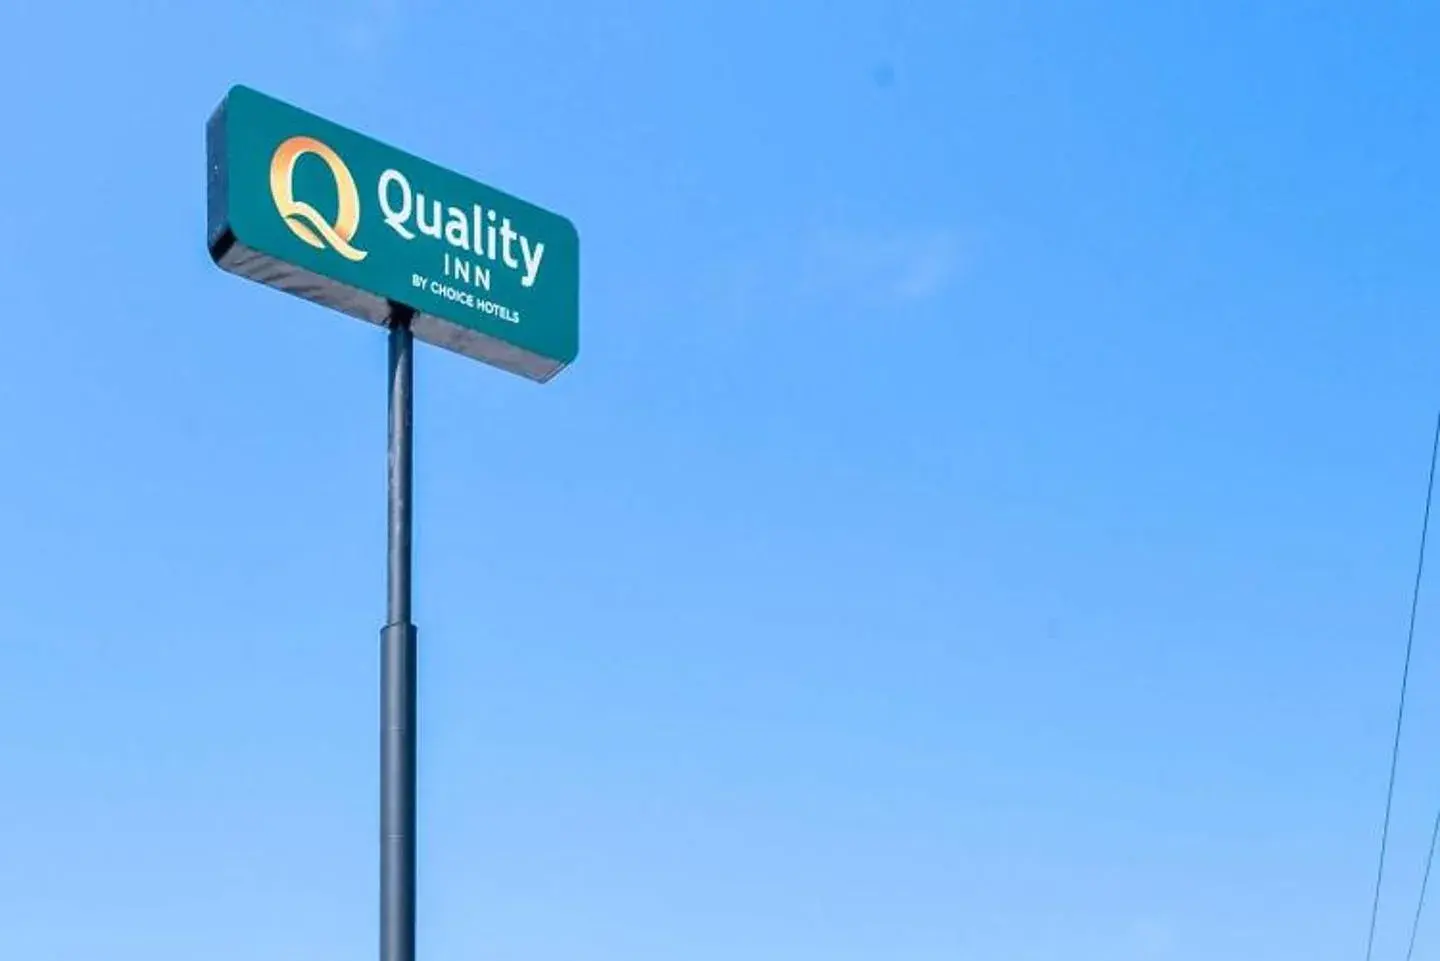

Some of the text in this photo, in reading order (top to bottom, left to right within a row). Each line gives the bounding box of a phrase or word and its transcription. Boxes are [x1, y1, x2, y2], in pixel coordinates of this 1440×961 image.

[270, 136, 367, 260] Q
[378, 169, 544, 286] Quality
[412, 273, 520, 323] BY CHOICE HOTELS
[444, 253, 490, 291] INN
